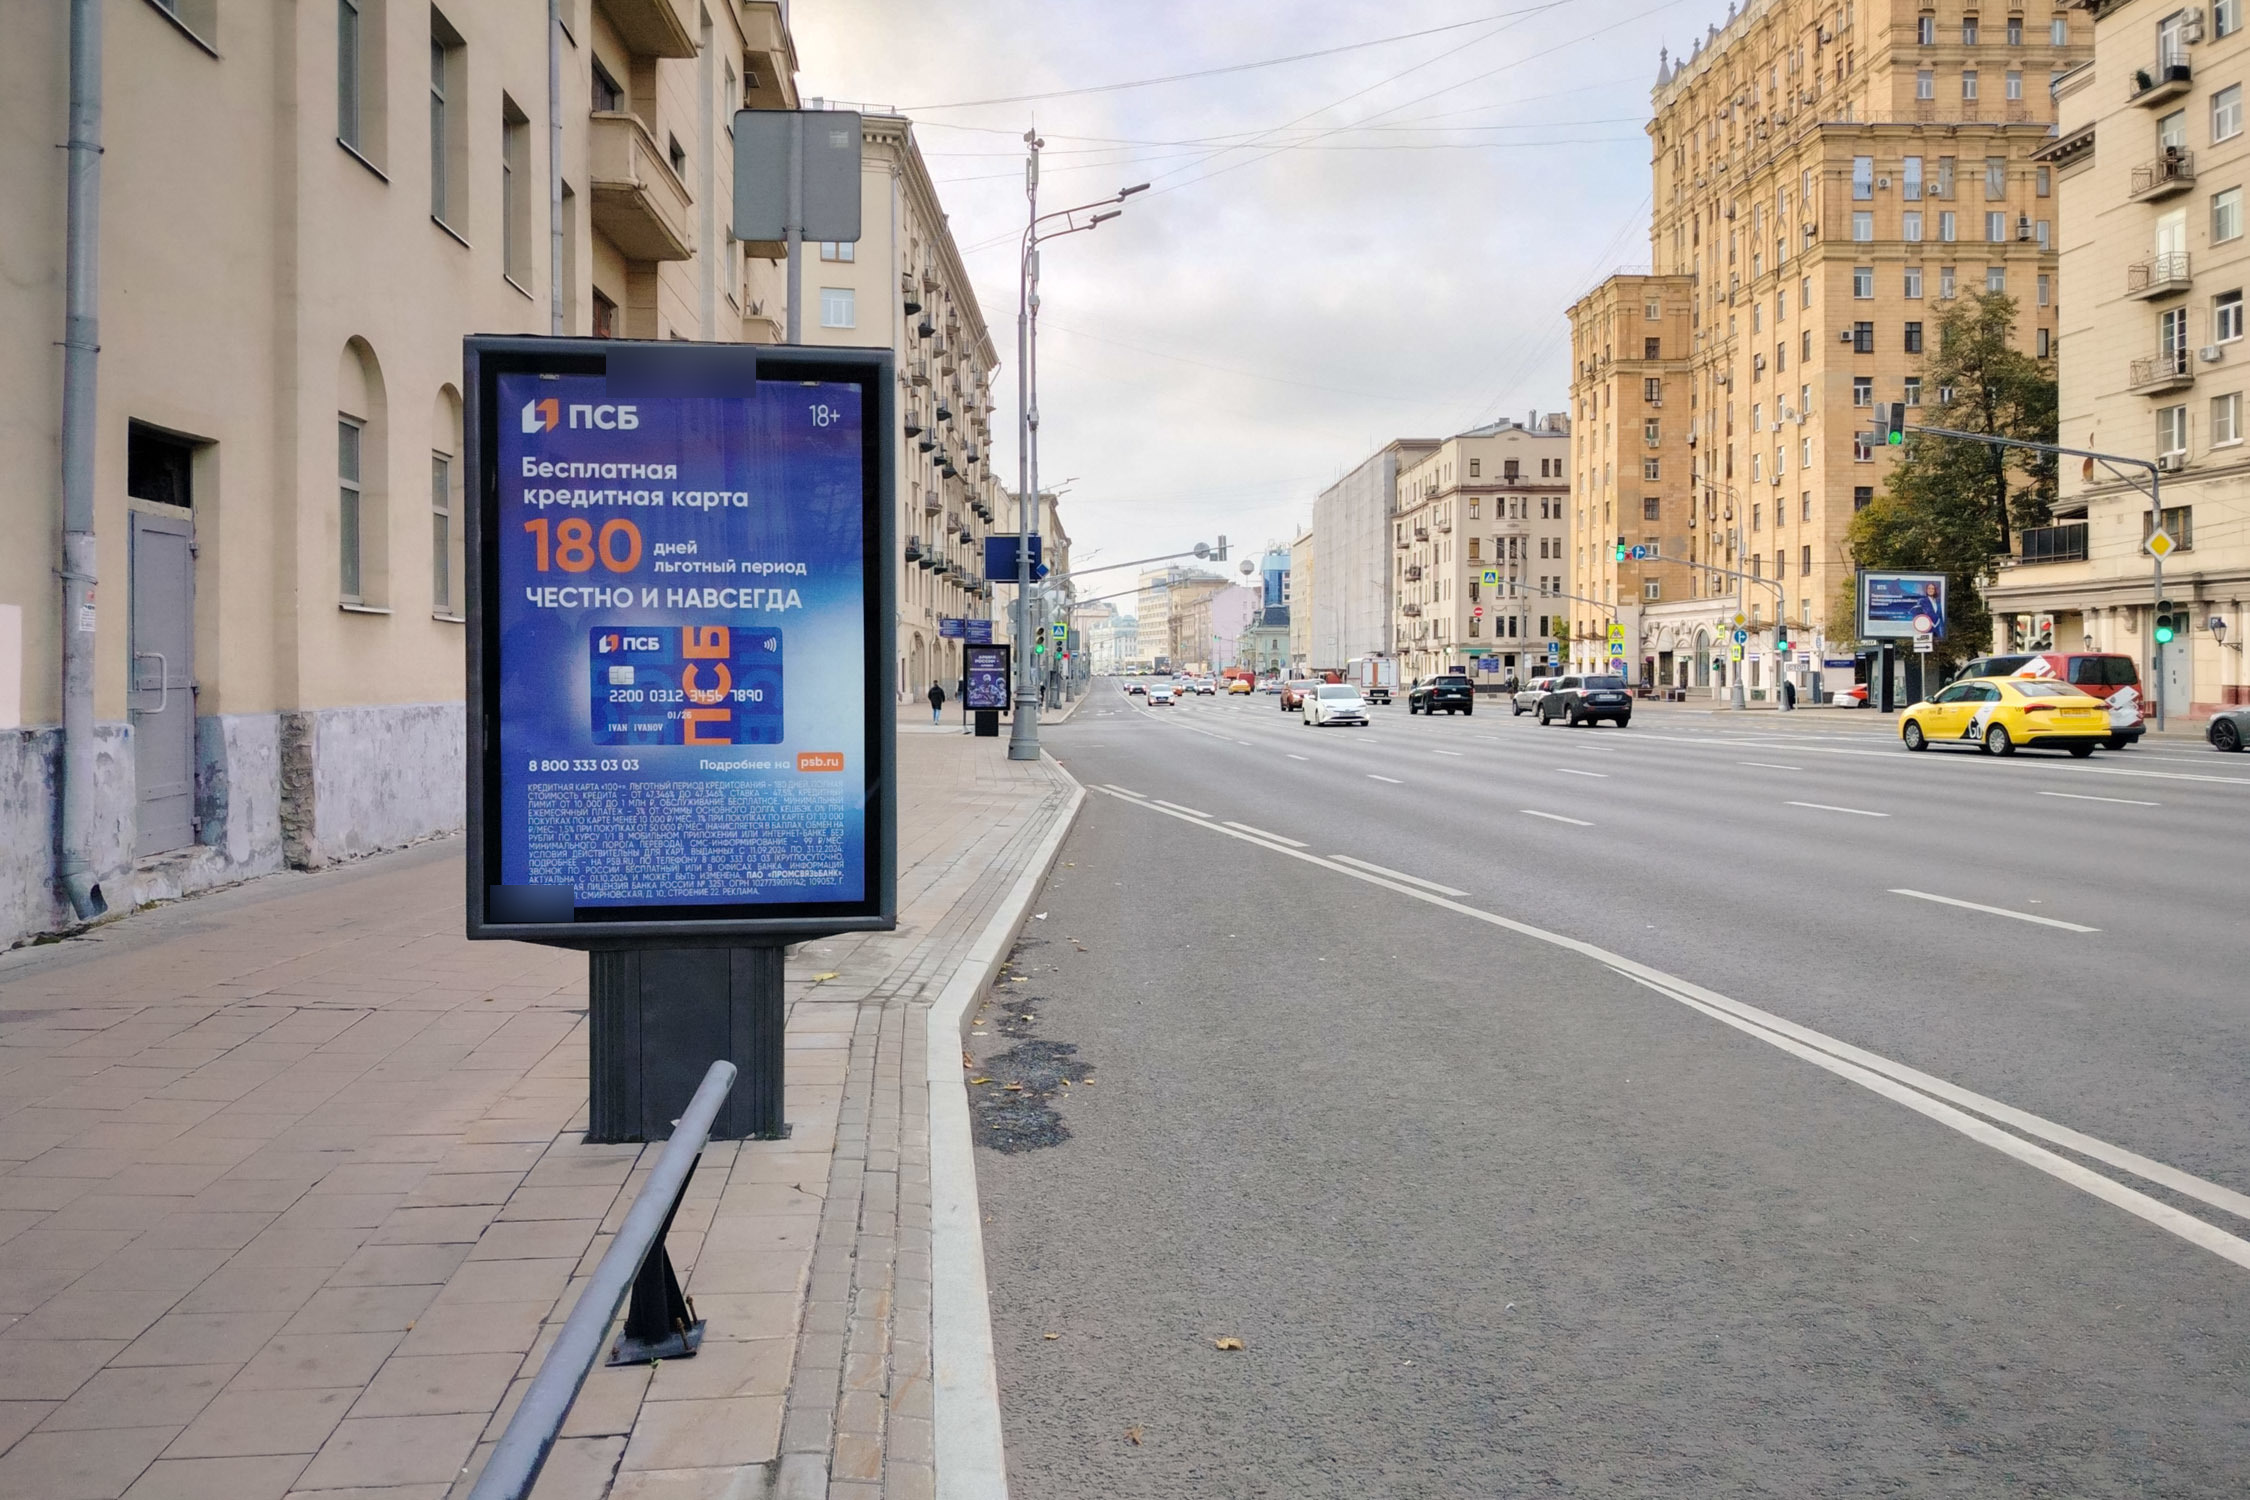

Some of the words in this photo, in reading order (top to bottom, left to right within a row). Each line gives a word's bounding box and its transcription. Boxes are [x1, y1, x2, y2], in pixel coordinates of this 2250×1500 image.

[569, 405, 639, 430] ПСБ
[809, 405, 840, 427] 18+
[522, 457, 677, 481] Бесплатная
[524, 485, 664, 509] кредитная
[672, 490, 748, 512] карта
[524, 518, 642, 573] 180
[654, 540, 697, 557] дней
[654, 558, 736, 574] льготный
[742, 560, 807, 576] период
[526, 588, 633, 608] ЧЕСТНО
[642, 588, 659, 608] И
[667, 588, 802, 612] НАВСЕГДА
[623, 637, 659, 652] ПСБ
[683, 625, 732, 745] ПСБ
[610, 689, 643, 703] 2200
[650, 689, 683, 703] 0312
[690, 689, 723, 703] 3456
[730, 689, 763, 702] 7890
[609, 723, 628, 732] IVAN
[634, 723, 663, 732] IVANOV
[529, 760, 538, 772] 8
[541, 760, 570, 772] 800
[573, 759, 599, 772] 333
[602, 759, 619, 771] 03
[622, 759, 639, 771] 03
[700, 759, 771, 771] Подробнее
[775, 761, 790, 769] на
[801, 756, 839, 769] psb.ru
[575, 782, 599, 790] КАРТА
[672, 781, 704, 789] ПЕРИОД
[527, 791, 578, 799] СТОИМОСТЬ
[528, 807, 588, 815] ЕЖЕМЕСЯЧНЫЙ
[695, 805, 746, 813] ОСНОВНОГО
[528, 840, 596, 848] МИНИМАЛЬНОГО
[572, 848, 639, 856] ДЕЙСТВИТЕЛЬНЫ
[667, 888, 708, 896] СТРОЕНИЕ
